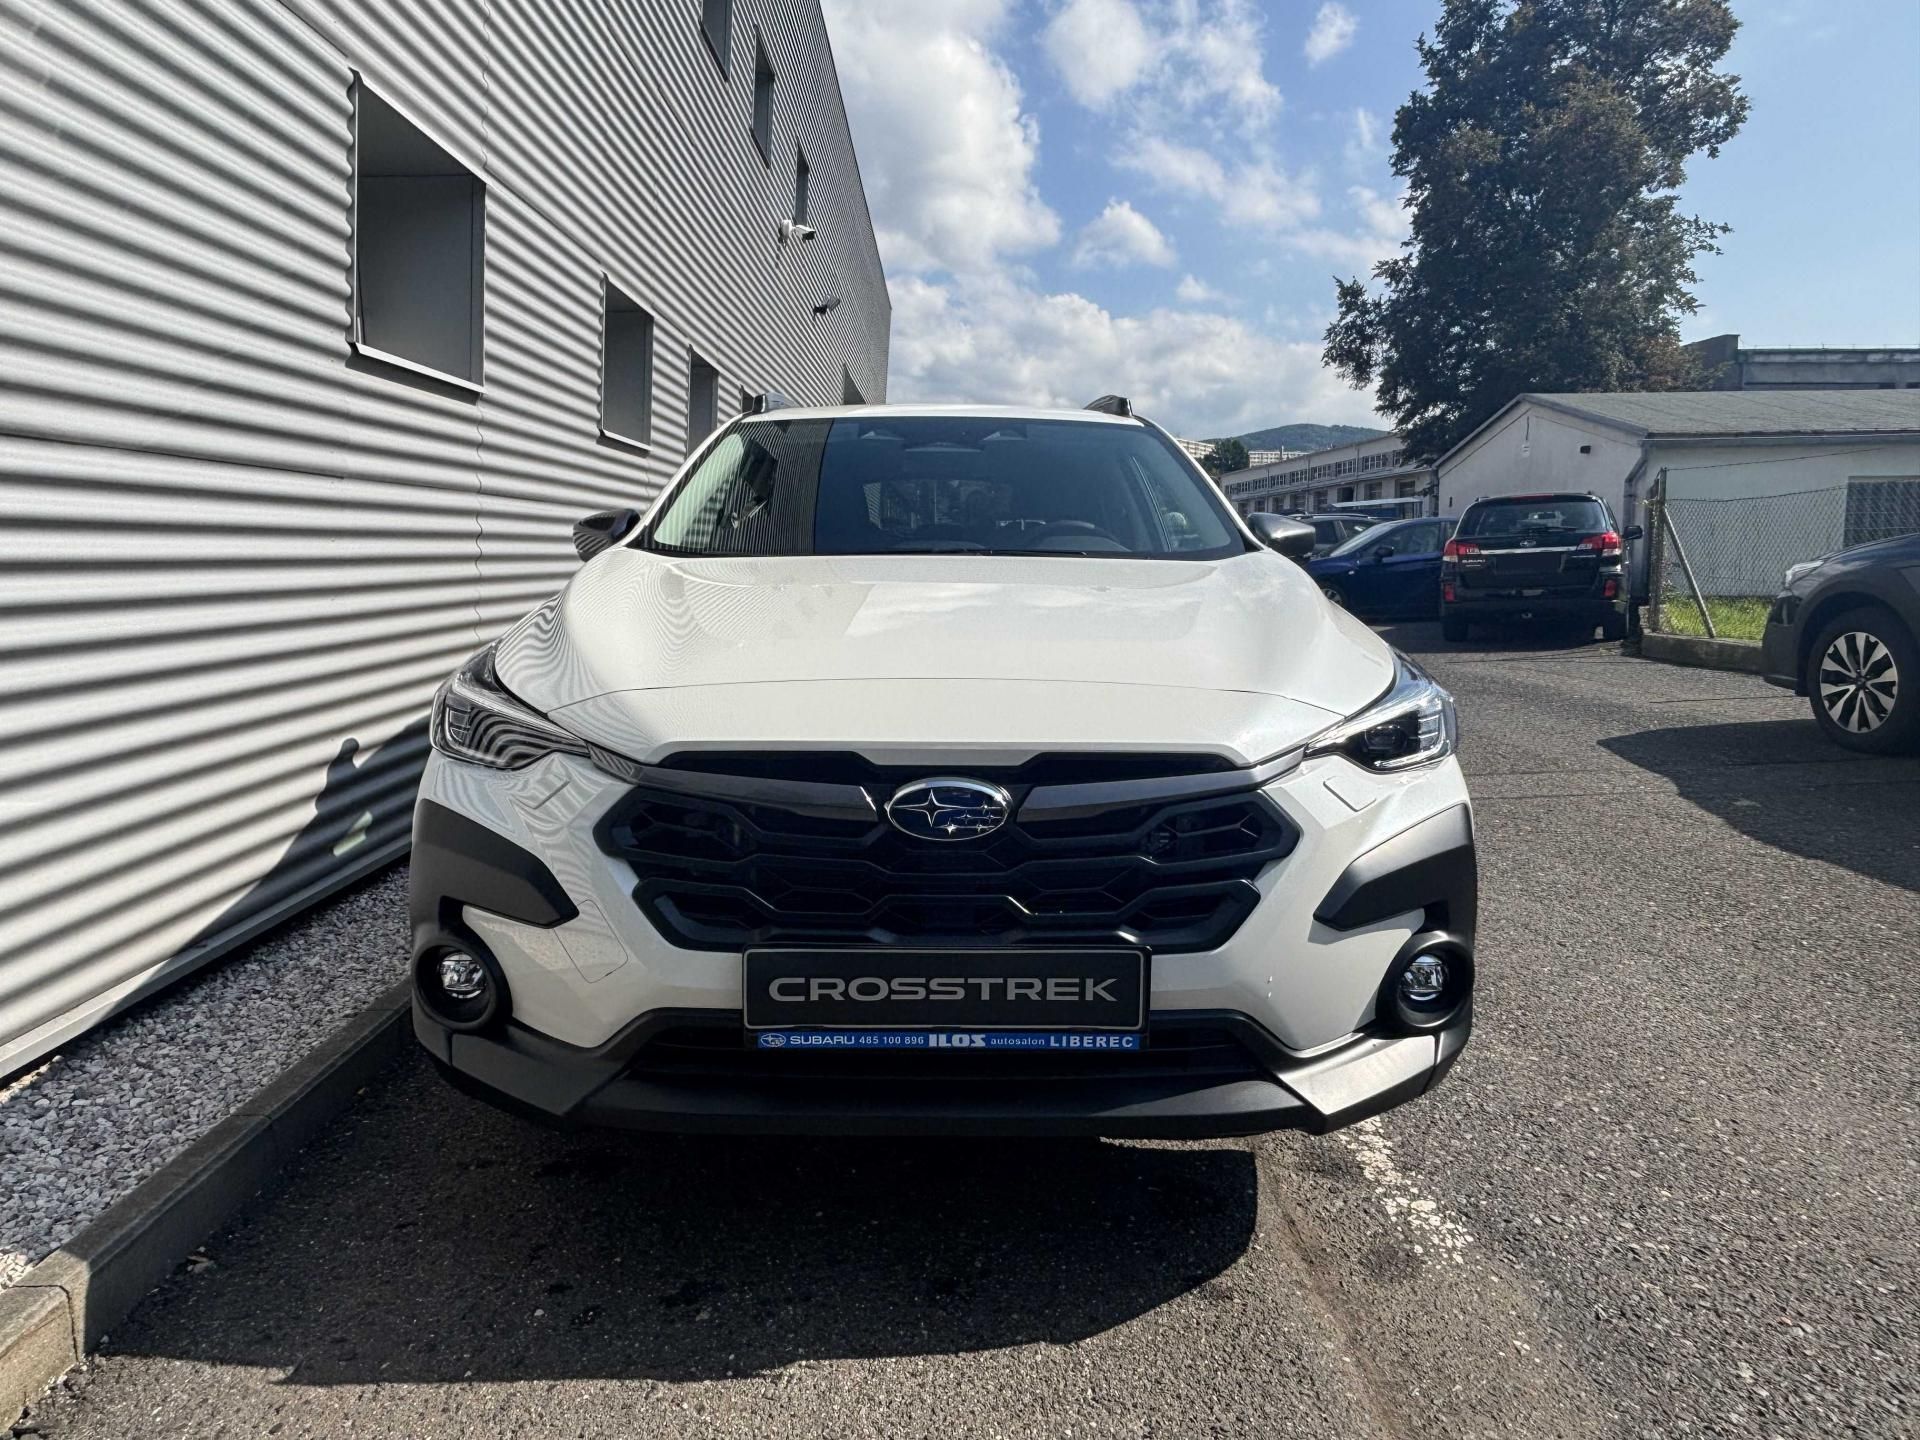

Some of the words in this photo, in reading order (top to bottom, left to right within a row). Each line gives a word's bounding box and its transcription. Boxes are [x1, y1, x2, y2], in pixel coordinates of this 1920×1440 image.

[768, 977, 1119, 1002] CROSSTREK
[789, 1035, 855, 1045] SUBARU
[858, 1036, 879, 1045] 485
[883, 1036, 902, 1045] 100
[904, 1036, 924, 1045] 896
[928, 1033, 987, 1048] ILOS
[990, 1036, 1046, 1046] autosalon
[1049, 1035, 1134, 1048] LIBEREC
